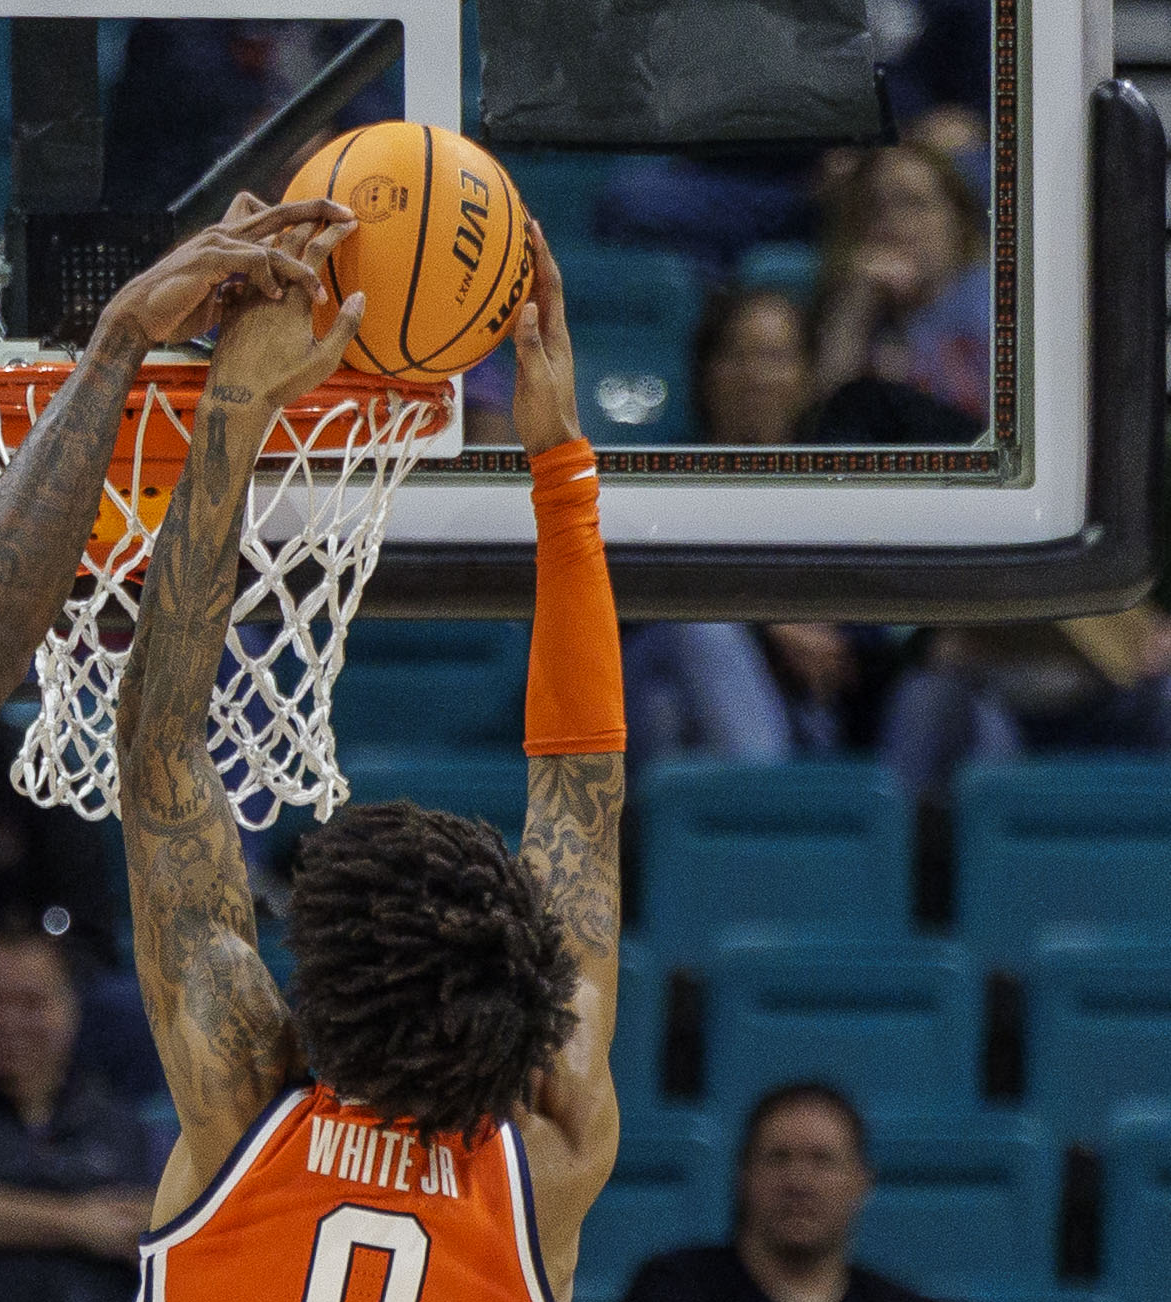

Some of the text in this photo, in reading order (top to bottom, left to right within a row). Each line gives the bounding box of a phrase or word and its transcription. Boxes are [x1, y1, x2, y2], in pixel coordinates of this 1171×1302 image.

[451, 167, 490, 306] EVO NXT
[306, 1115, 460, 1200] WHITE JR
